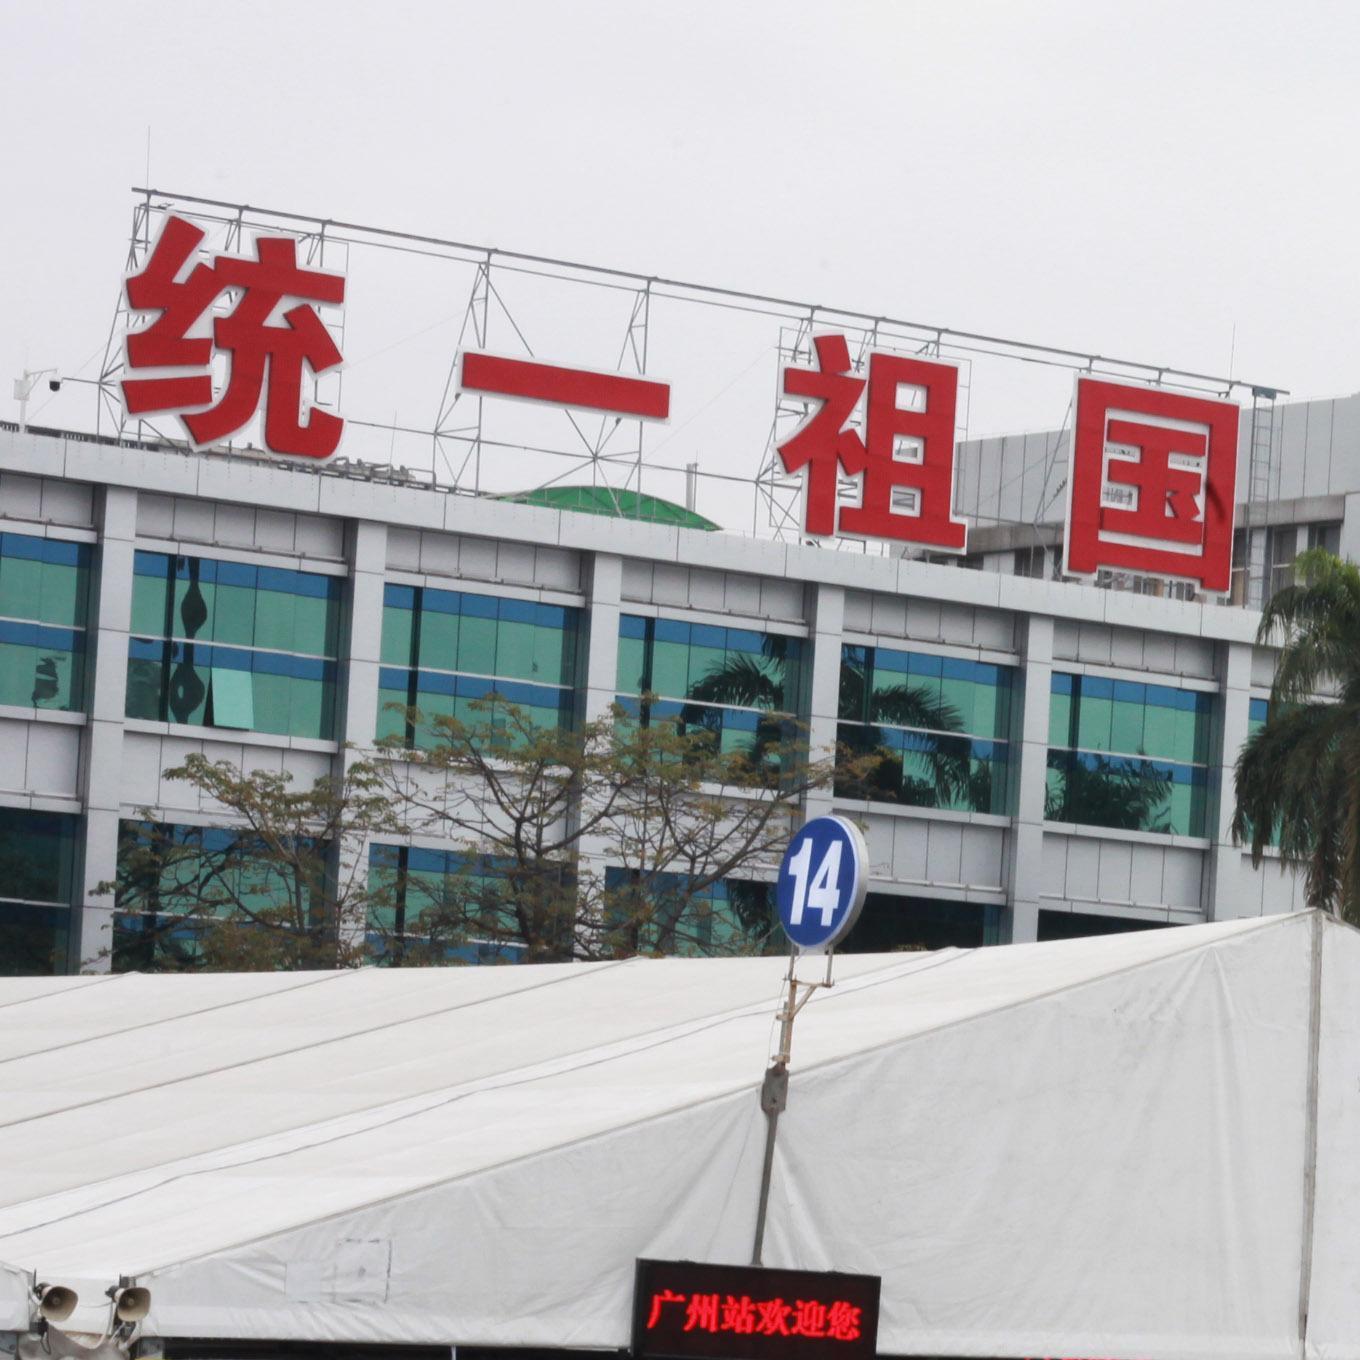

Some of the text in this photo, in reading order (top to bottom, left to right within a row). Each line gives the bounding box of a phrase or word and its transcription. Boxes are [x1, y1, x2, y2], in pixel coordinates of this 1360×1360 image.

[123, 215, 1241, 593] 统一祖国
[788, 838, 843, 927] 14
[646, 1289, 862, 1341] 广州站欢迎您
